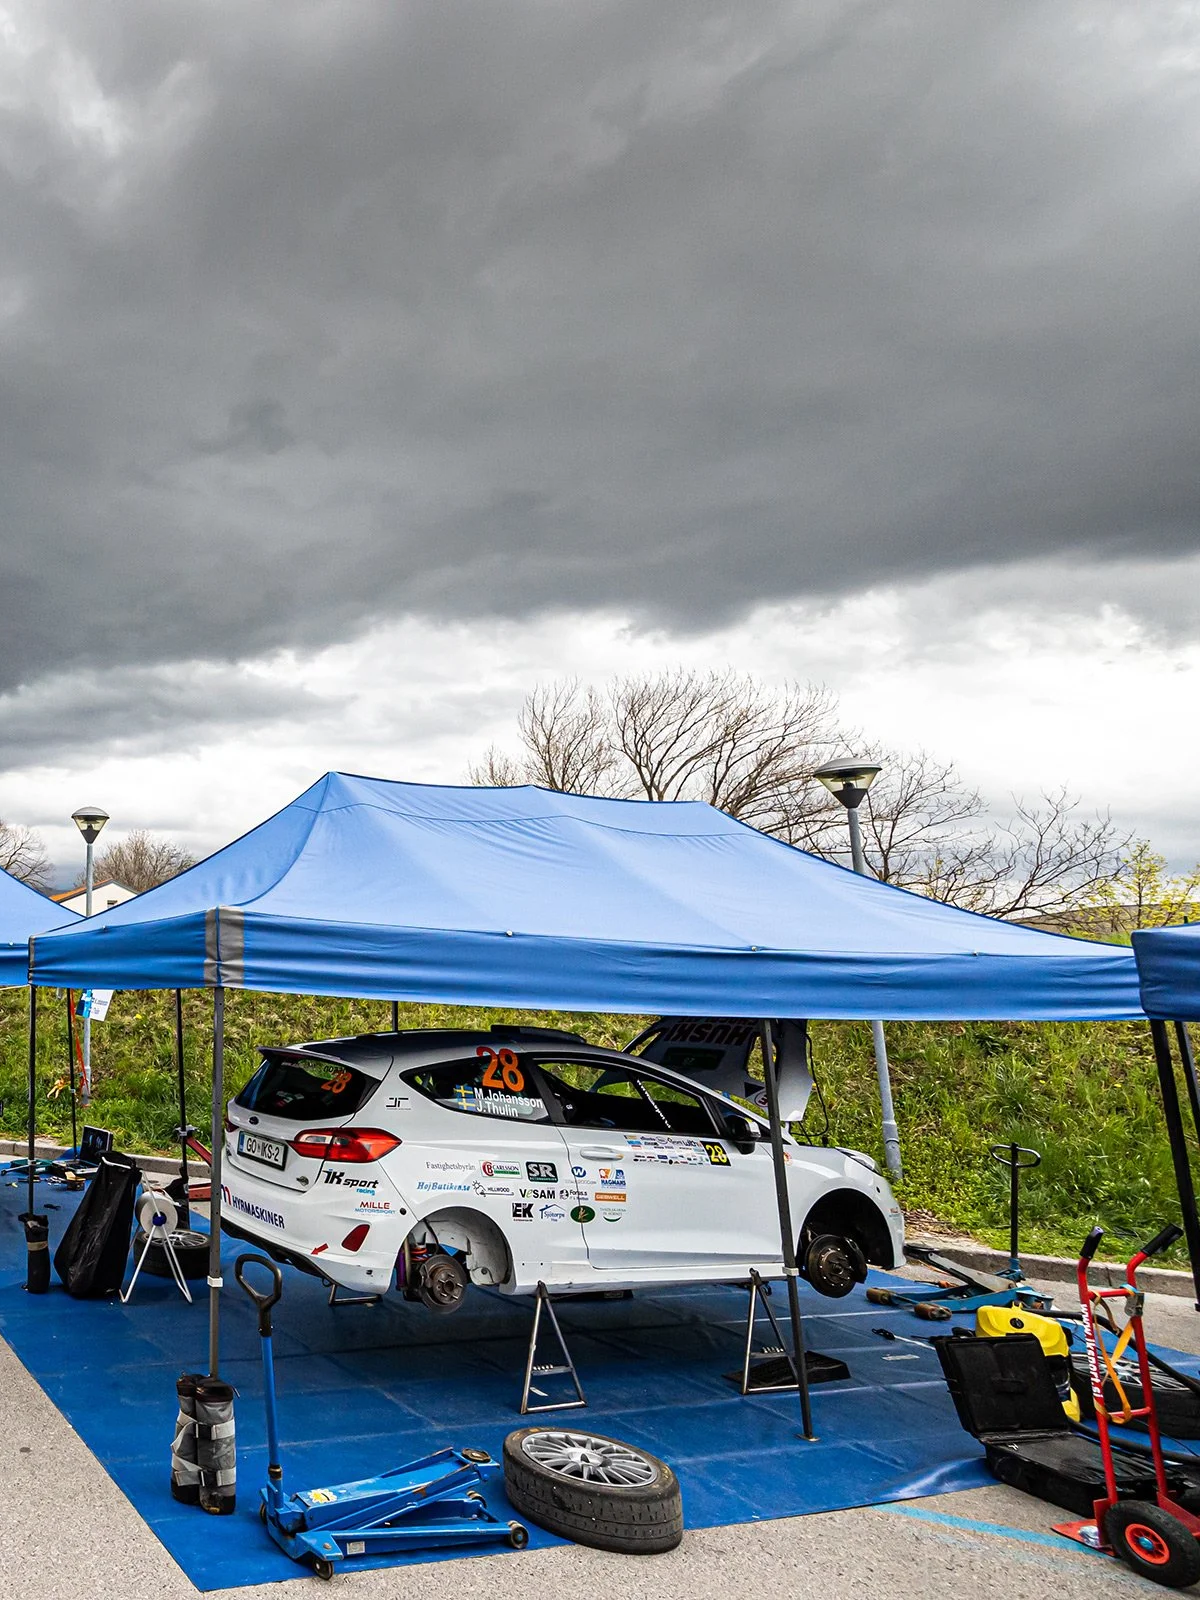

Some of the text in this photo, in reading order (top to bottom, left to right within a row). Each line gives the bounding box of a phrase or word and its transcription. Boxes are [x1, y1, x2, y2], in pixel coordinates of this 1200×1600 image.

[476, 1046, 524, 1092] 28
[321, 1072, 352, 1094] 28
[246, 1138, 257, 1154] GO
[706, 1144, 727, 1163] 28
[528, 1163, 556, 1178] SR
[356, 1188, 376, 1196] racing
[232, 1195, 285, 1229] HYRMASKINER
[360, 1201, 390, 1209] MILLE
